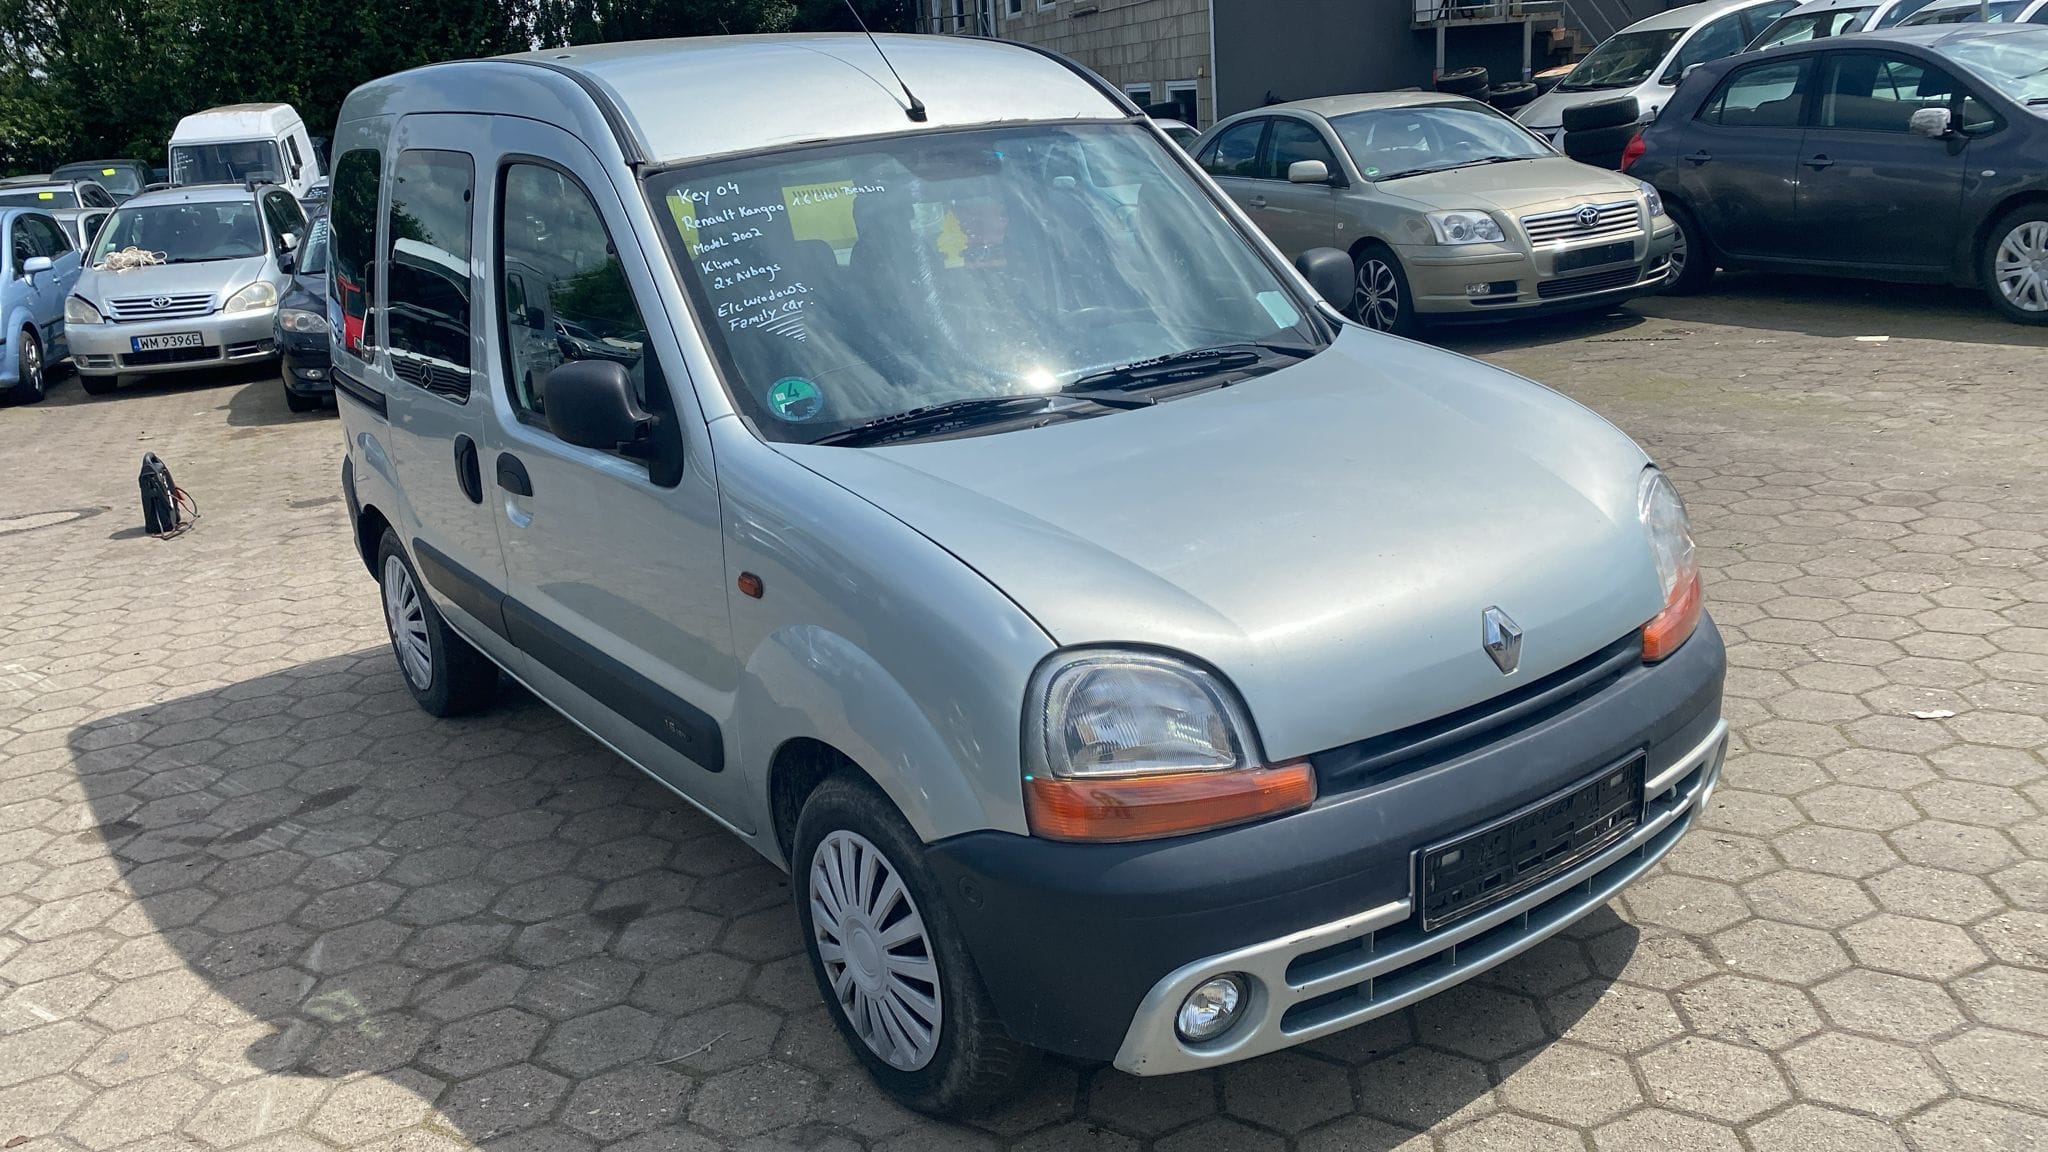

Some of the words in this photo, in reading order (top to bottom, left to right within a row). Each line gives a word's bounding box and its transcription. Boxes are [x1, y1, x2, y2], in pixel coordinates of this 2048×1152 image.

[676, 188, 710, 206] Key
[681, 208, 736, 231] Renault
[738, 203, 785, 223] Kangoo
[731, 227, 763, 243] 2002
[701, 257, 741, 274] Klima
[714, 276, 734, 290] 2x
[736, 263, 782, 282] Airbags
[728, 308, 777, 332] Family
[140, 337, 159, 350] WM
[162, 334, 202, 347] 9396E
[788, 382, 801, 398] 4
